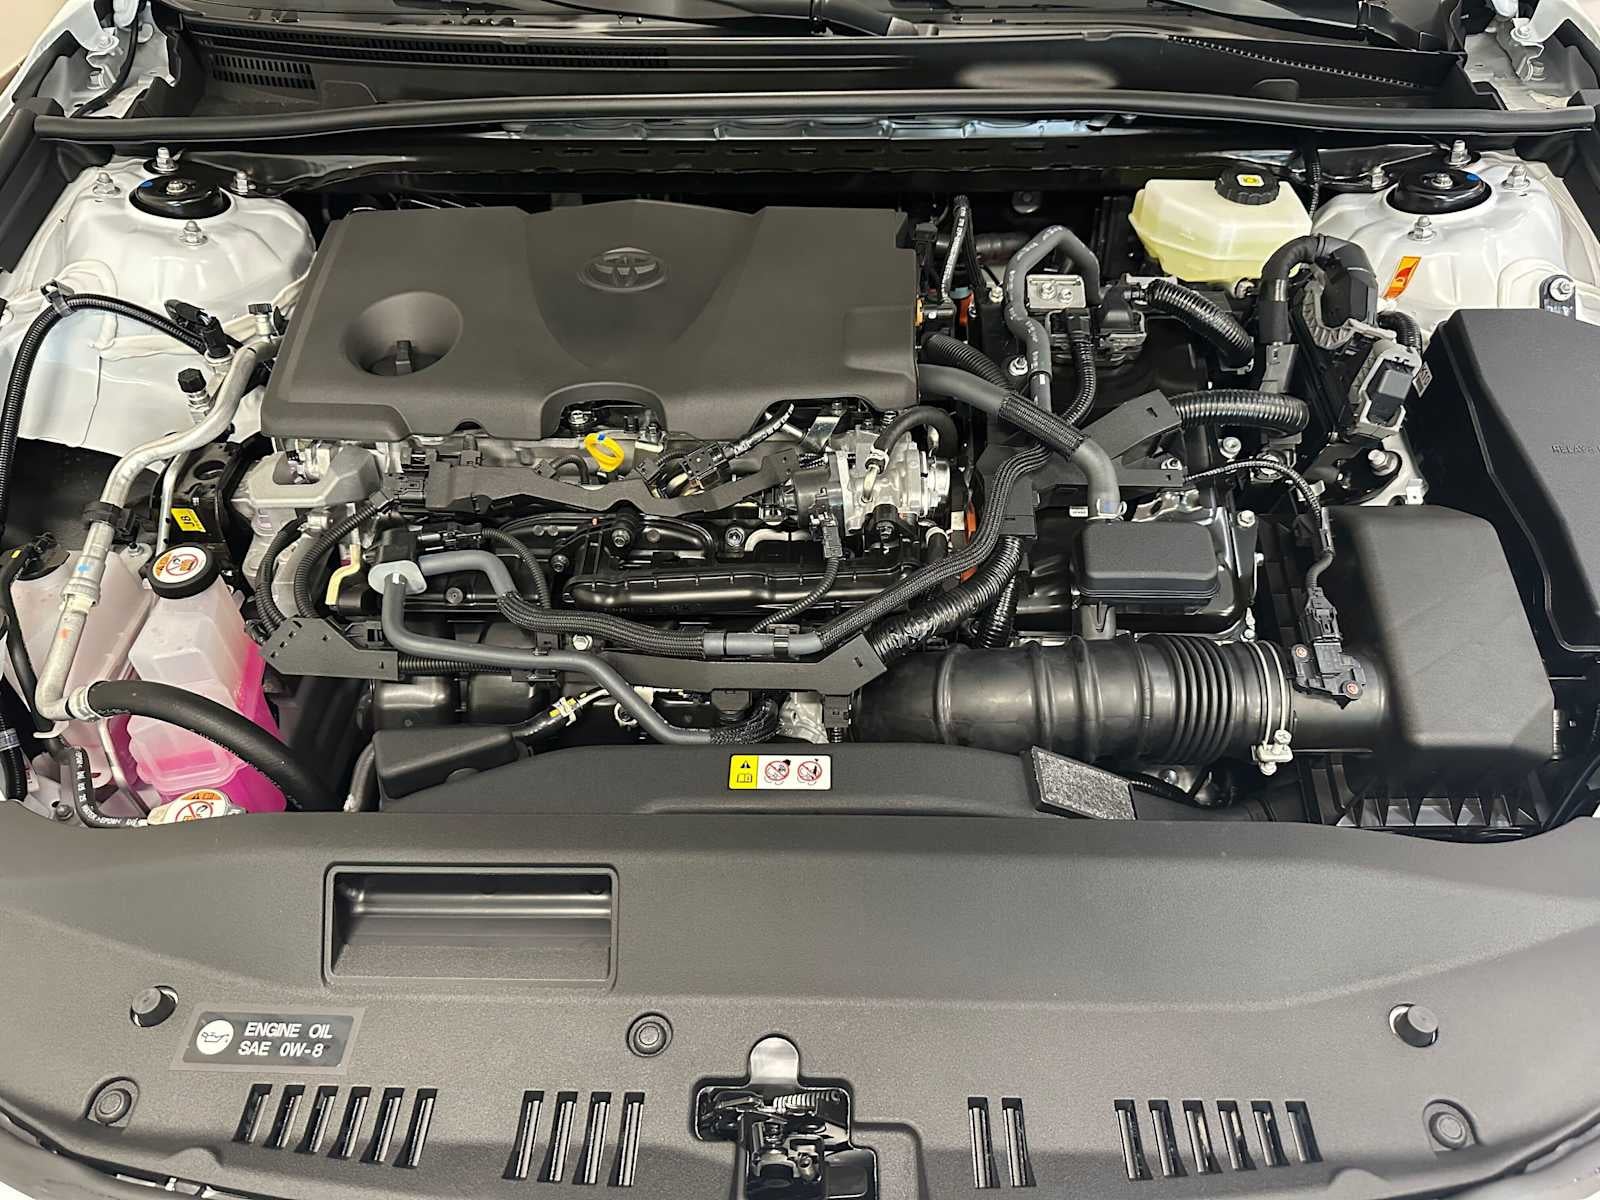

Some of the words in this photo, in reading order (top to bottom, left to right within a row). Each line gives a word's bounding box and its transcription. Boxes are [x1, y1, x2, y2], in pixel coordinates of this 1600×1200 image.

[243, 1022, 302, 1038] ENGINE
[308, 1023, 334, 1039] OIL
[237, 1040, 272, 1056] SAE
[279, 1041, 325, 1058] 0W-8
